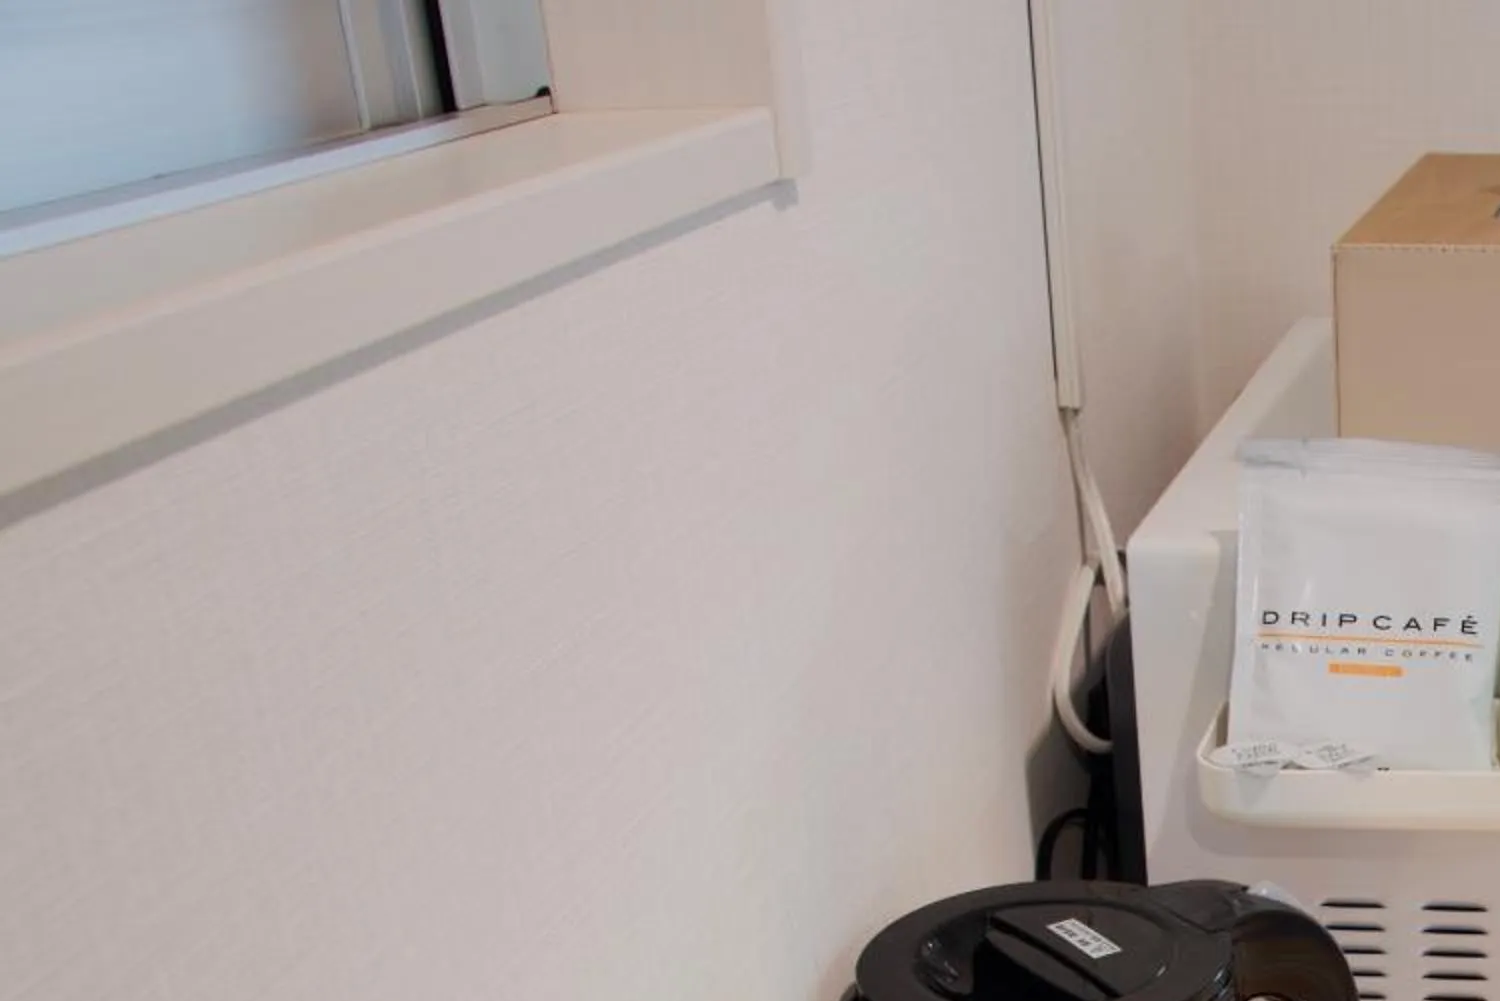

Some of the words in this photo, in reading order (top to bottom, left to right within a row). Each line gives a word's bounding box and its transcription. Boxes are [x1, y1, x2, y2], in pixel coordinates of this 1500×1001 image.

[1261, 610, 1358, 628] DRIP
[1372, 615, 1479, 635] CAFÉ
[1384, 649, 1474, 662] COFFEE
